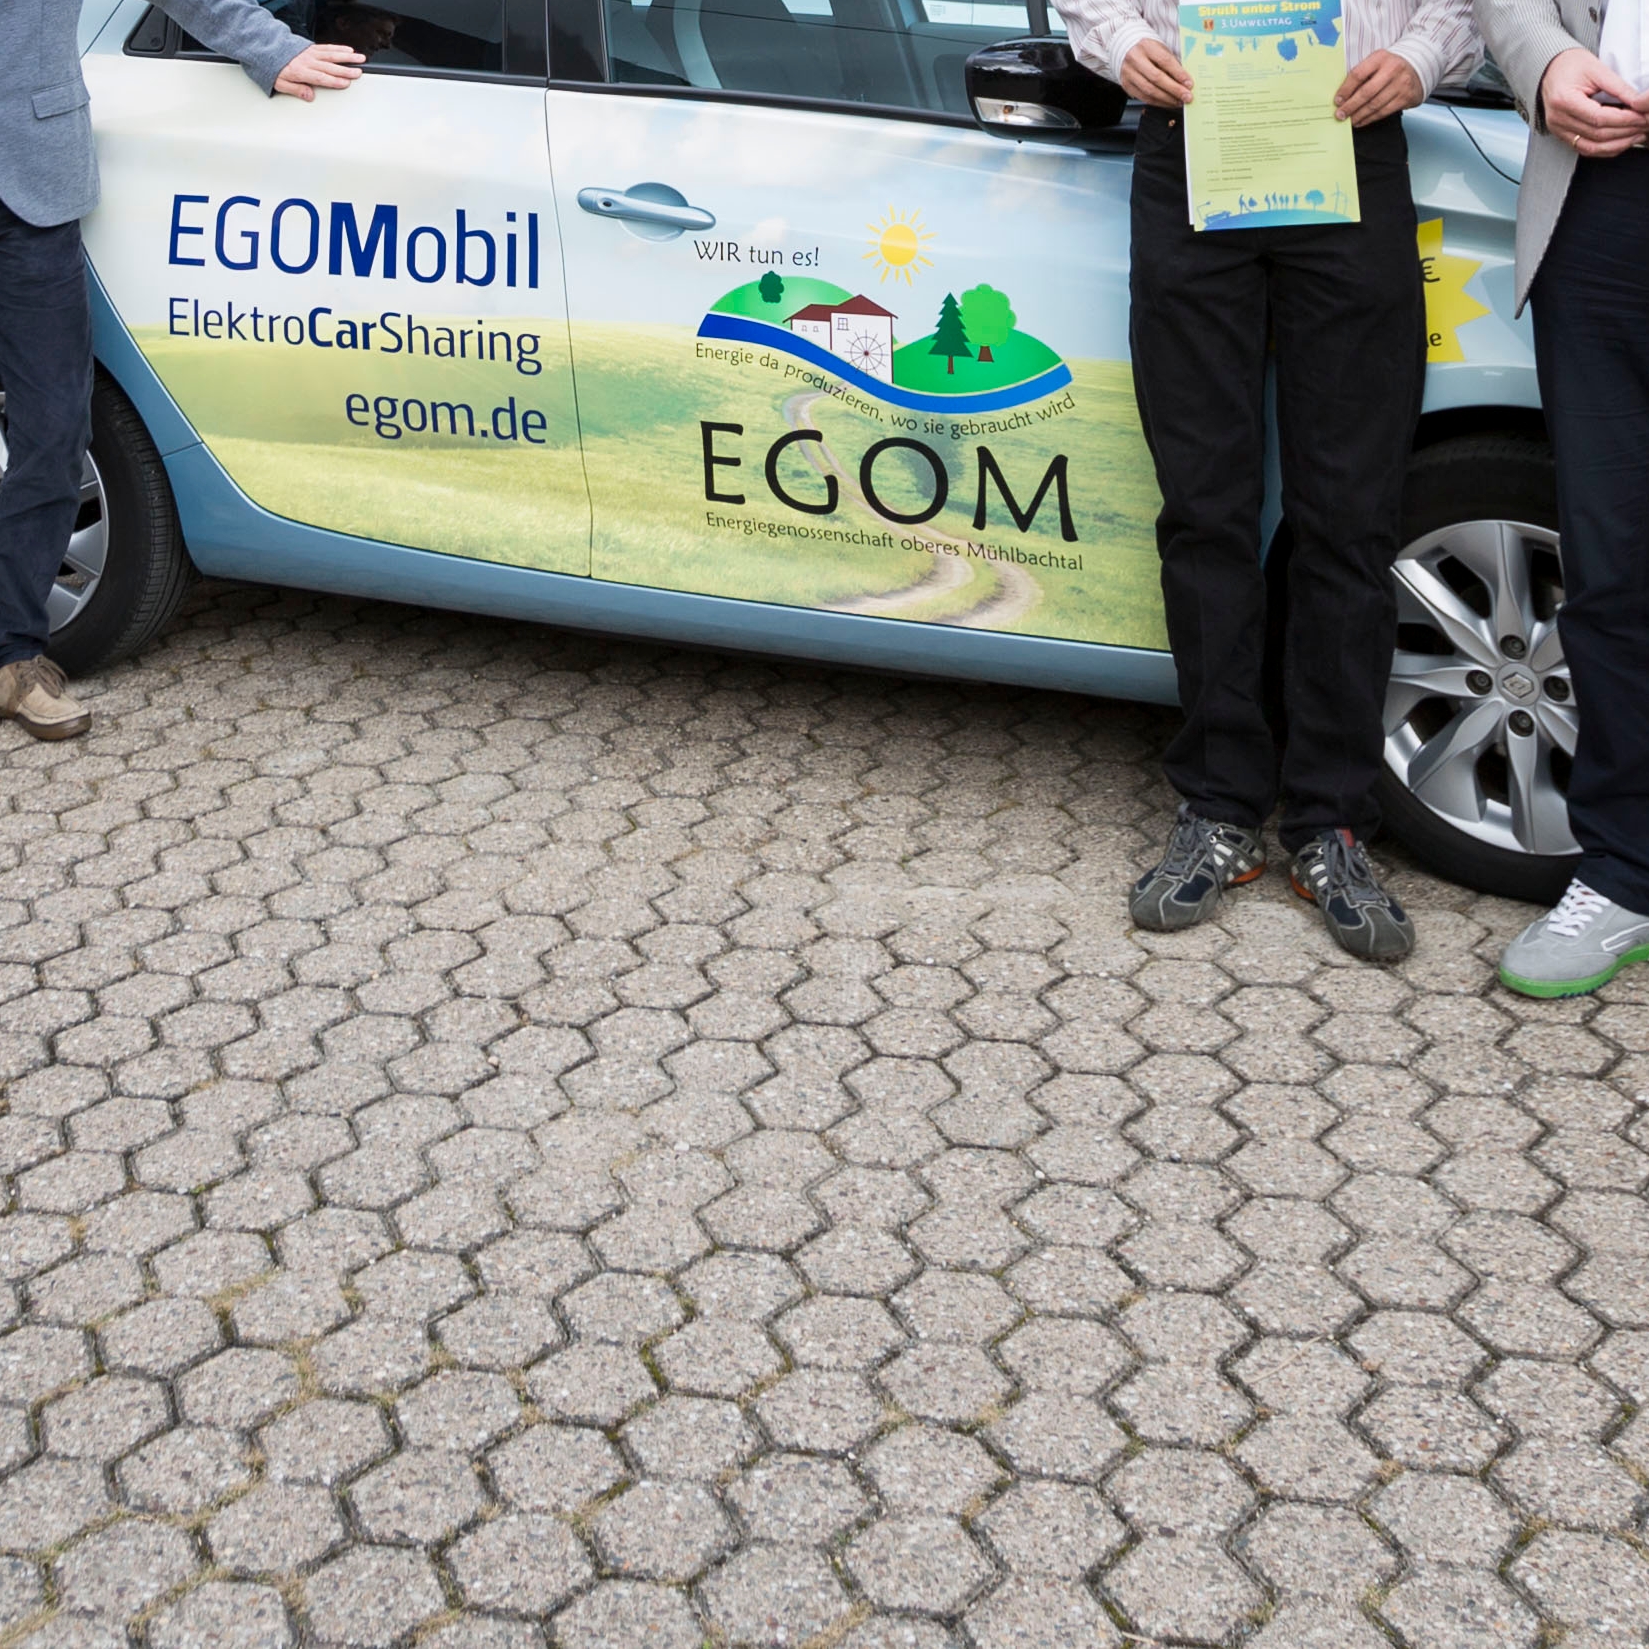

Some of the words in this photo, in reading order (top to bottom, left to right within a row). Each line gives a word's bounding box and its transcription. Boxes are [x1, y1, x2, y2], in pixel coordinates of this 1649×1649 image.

[1241, 4, 1277, 14] unter
[1280, 0, 1321, 12] Strom
[168, 194, 539, 289] EGOMobil
[693, 240, 741, 263] WIR
[749, 246, 783, 265] tun
[792, 247, 819, 267] es!
[169, 296, 542, 376] ElektroCarSharing
[345, 393, 548, 444] egom.de
[695, 342, 753, 366] Energie
[759, 353, 779, 370] da
[890, 414, 918, 431] wo
[923, 418, 944, 435] sie
[950, 413, 1033, 440] gebraucht
[1036, 392, 1076, 422] wird
[700, 420, 1079, 543] EGOM
[705, 511, 895, 550] Energiegenossenschaft
[900, 535, 961, 557] oberes
[966, 542, 1084, 572] Mühlbachtal
